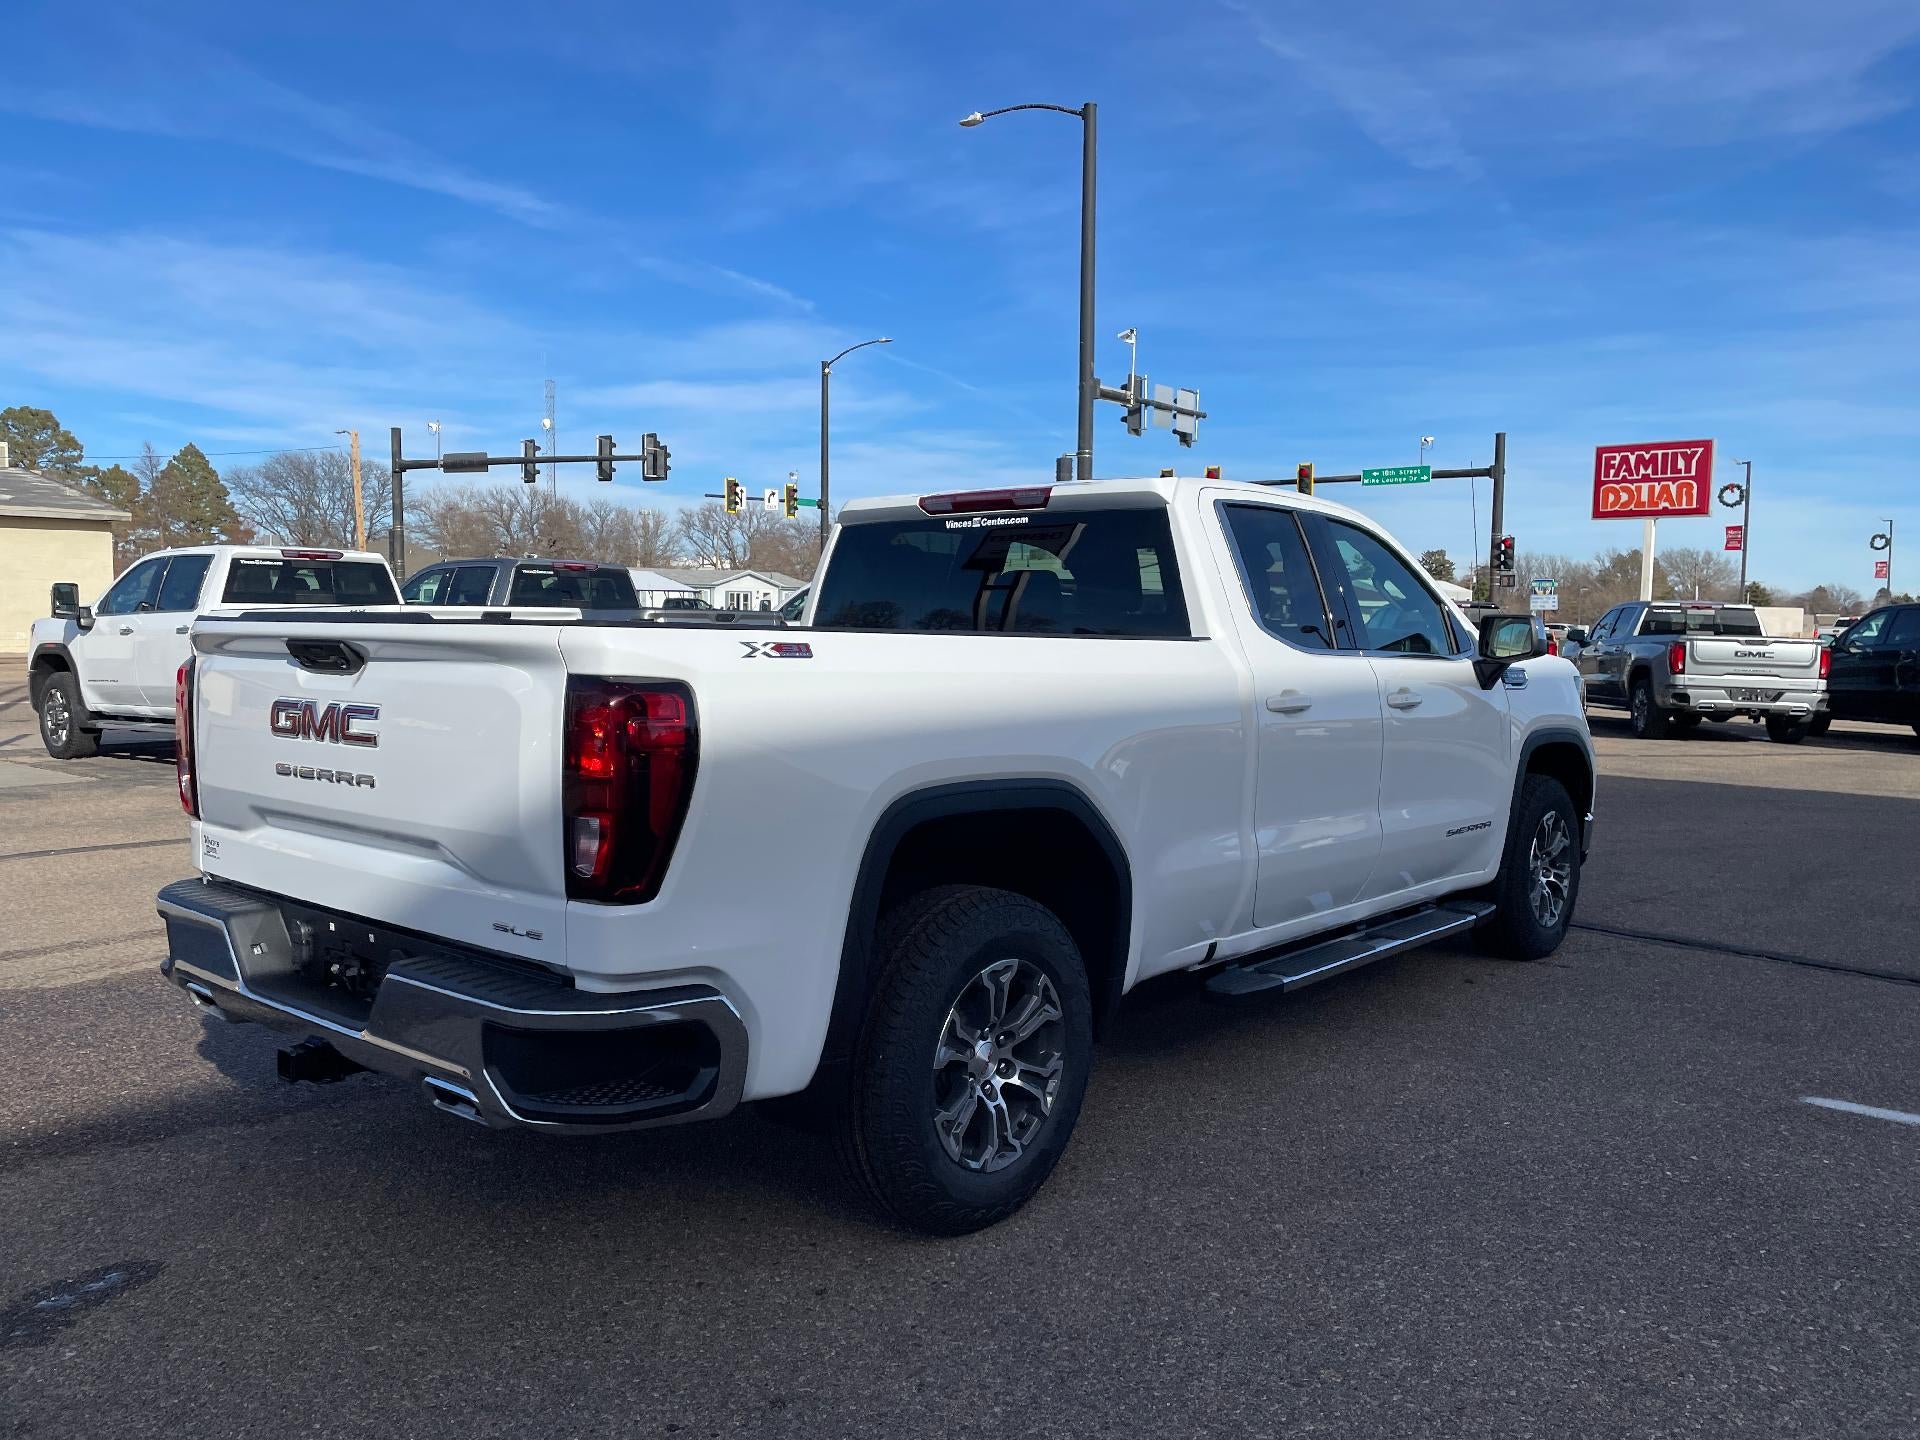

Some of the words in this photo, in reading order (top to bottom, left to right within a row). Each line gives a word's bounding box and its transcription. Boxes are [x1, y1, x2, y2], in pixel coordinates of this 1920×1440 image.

[1601, 448, 1704, 480] FAMILY
[1600, 480, 1698, 512] DOLLAR
[1734, 650, 1775, 659] GMC
[270, 696, 382, 750] GMC
[275, 762, 377, 789] SIERRA
[1446, 821, 1492, 838] SIERRA
[492, 922, 544, 941] SLE
